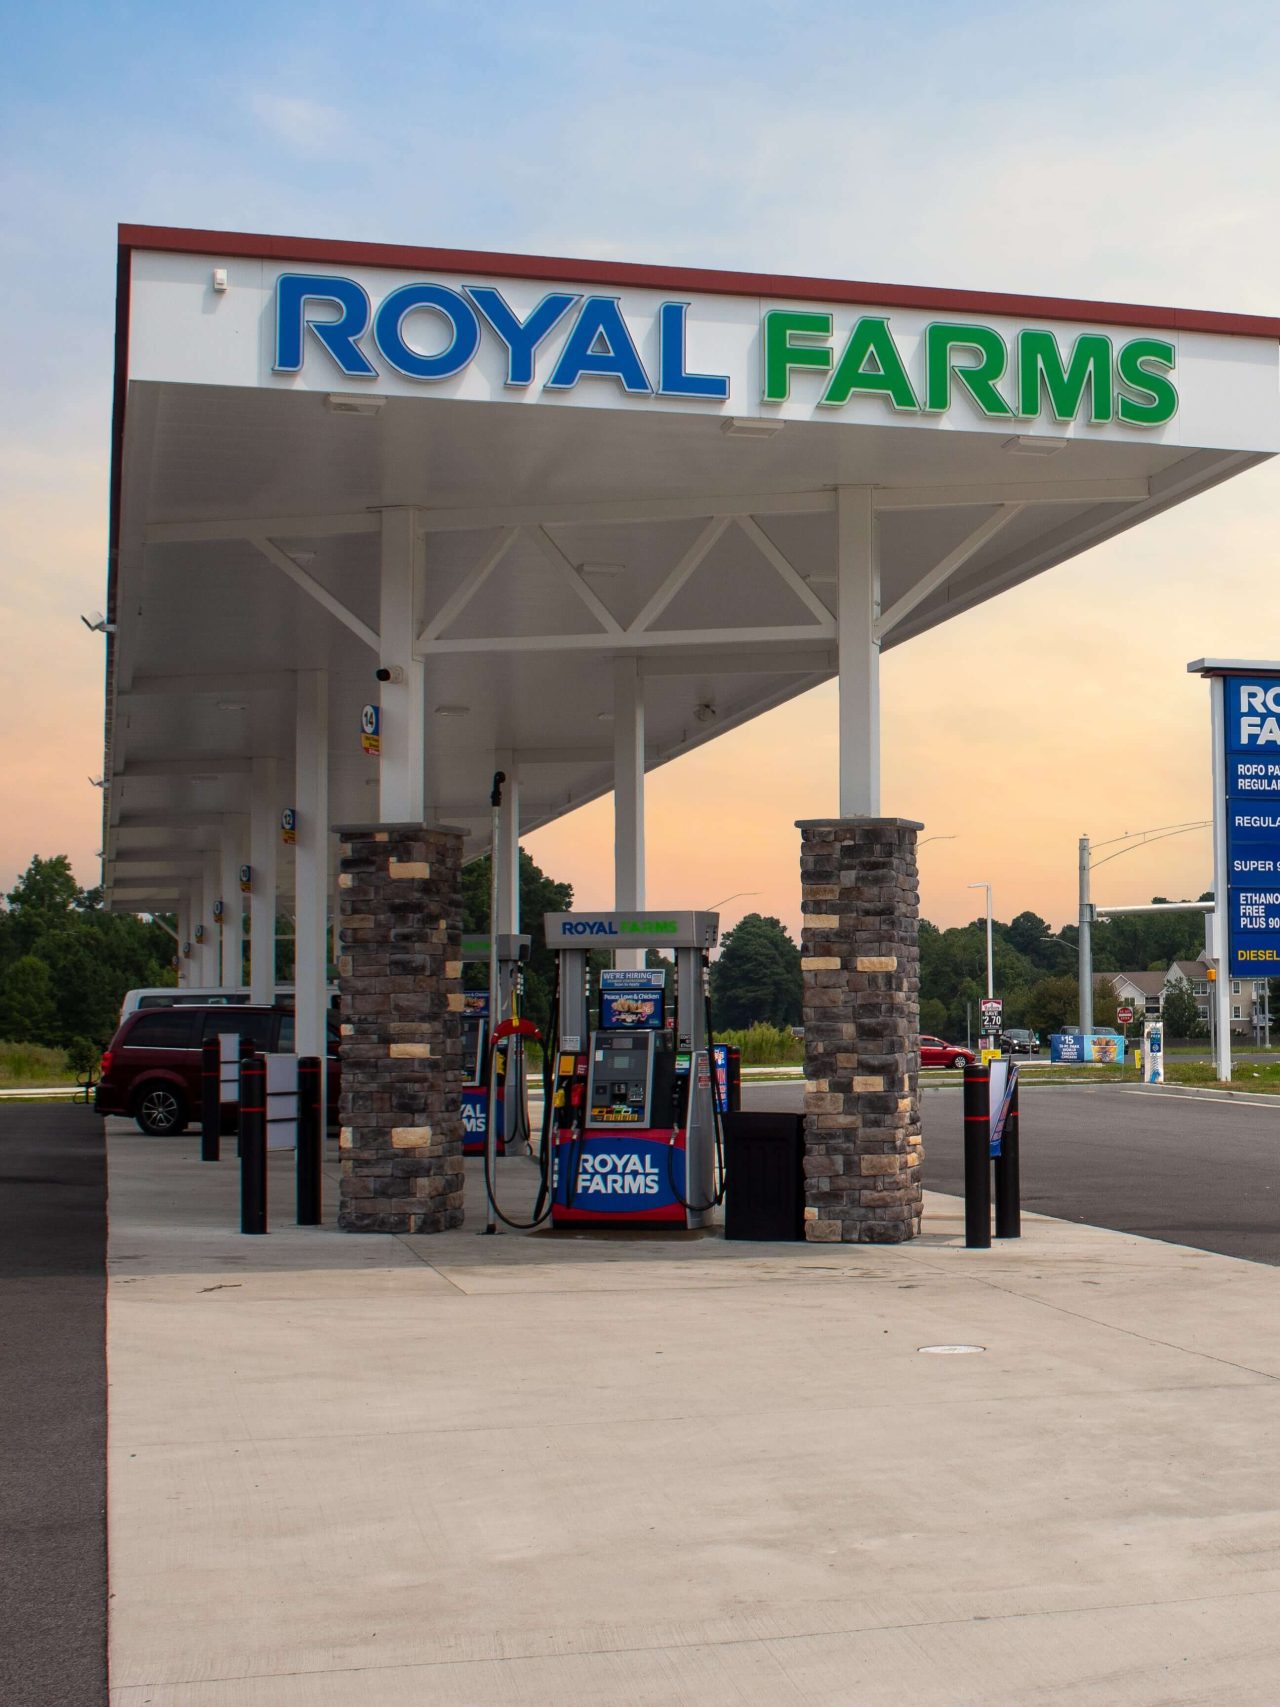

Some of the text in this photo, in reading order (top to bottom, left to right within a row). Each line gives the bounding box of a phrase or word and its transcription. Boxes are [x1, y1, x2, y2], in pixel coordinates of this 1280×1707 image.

[272, 273, 1179, 428] ROYAL FARMS
[363, 711, 374, 729] 14
[1238, 764, 1266, 776] ROFO
[1234, 860, 1274, 872] SUPER
[1240, 906, 1266, 916] FREE
[562, 920, 678, 936] ROYAL FARMS
[1240, 918, 1280, 928] PLUS 90
[1238, 950, 1280, 960] DIESEL
[1061, 1035, 1074, 1044] $15
[579, 1154, 659, 1174] ROYAL
[576, 1174, 660, 1194] FARMS
